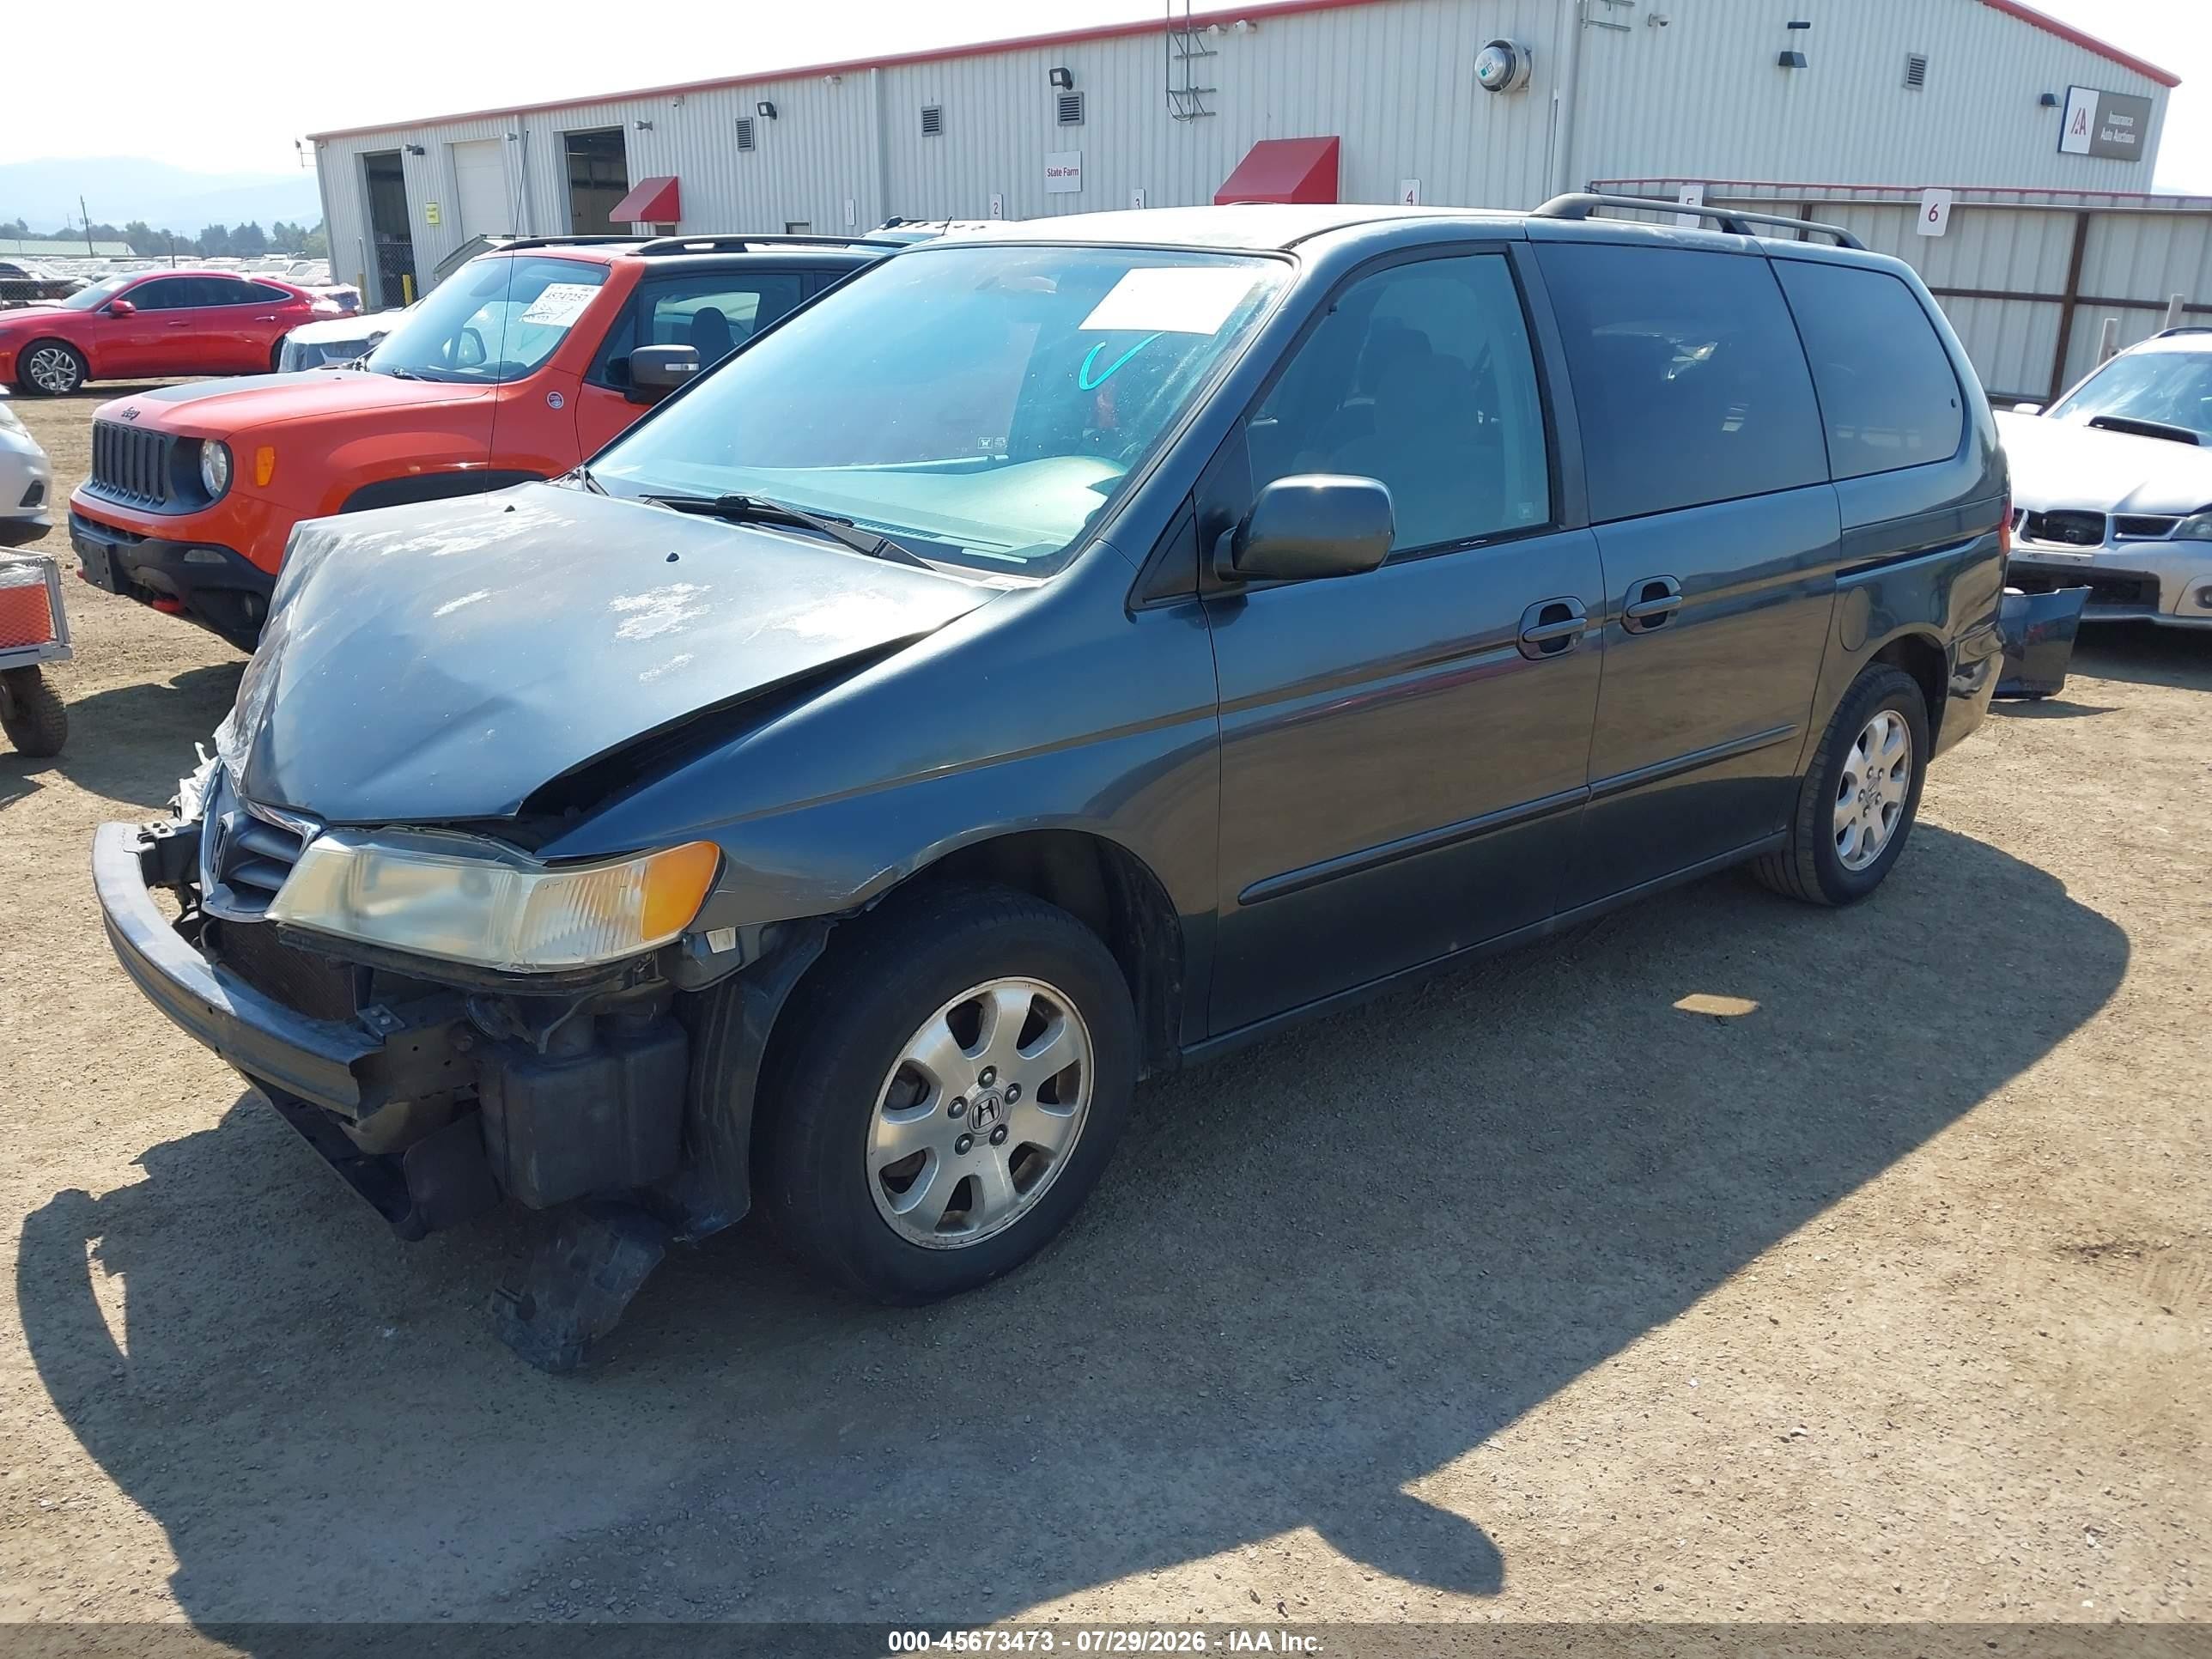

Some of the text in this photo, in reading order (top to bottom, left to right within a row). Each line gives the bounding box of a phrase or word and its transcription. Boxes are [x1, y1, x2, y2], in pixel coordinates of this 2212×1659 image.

[1047, 167, 1079, 177] State Farm
[1406, 190, 1413, 206] 4
[994, 202, 999, 215] 2
[1928, 203, 1939, 222] 6
